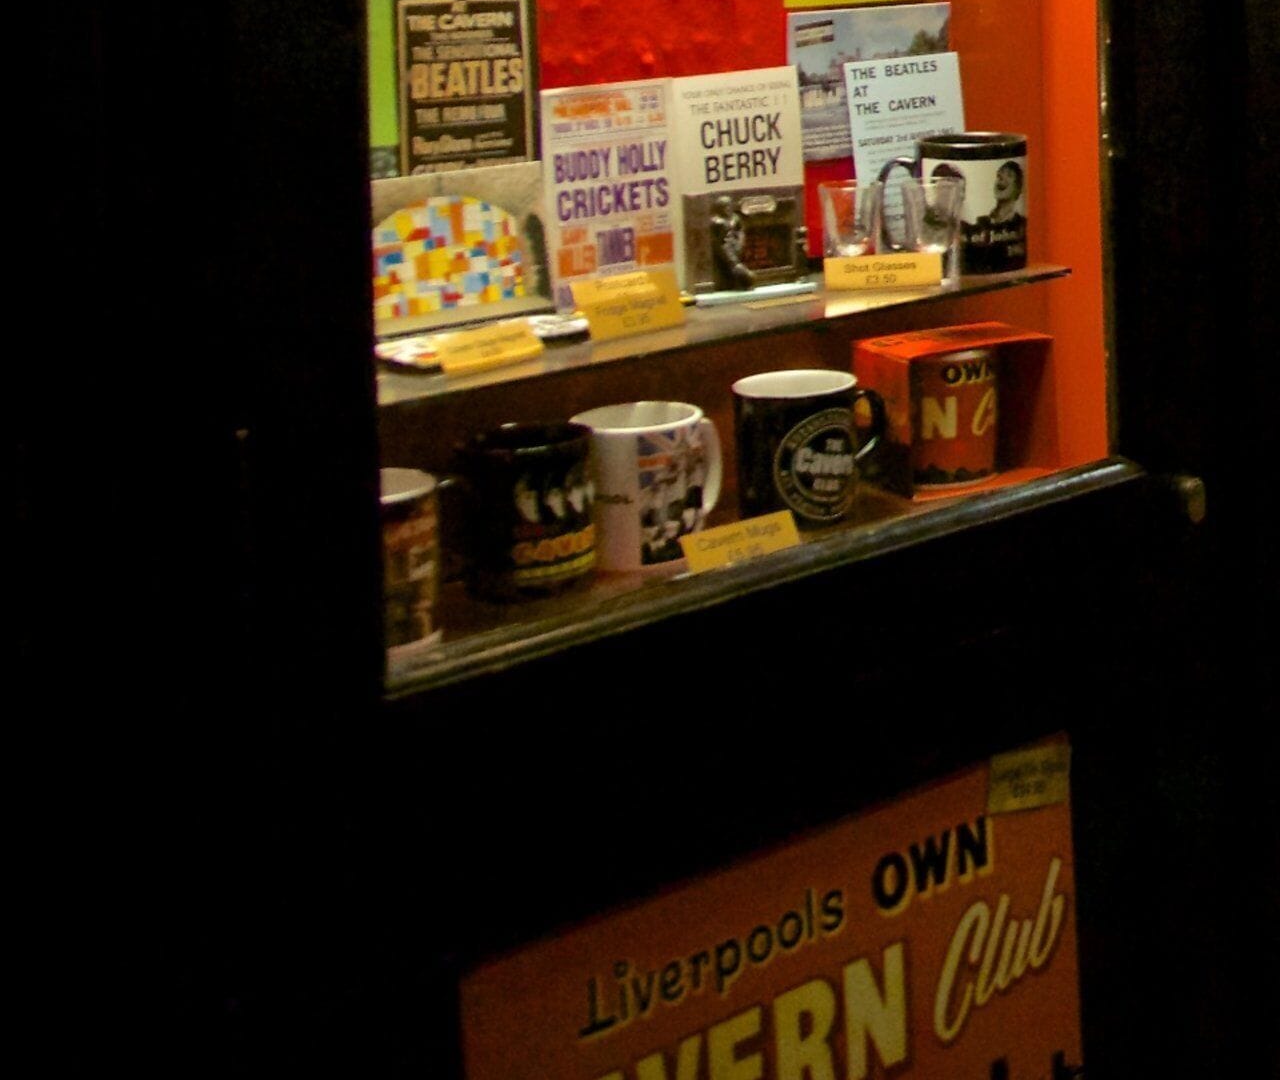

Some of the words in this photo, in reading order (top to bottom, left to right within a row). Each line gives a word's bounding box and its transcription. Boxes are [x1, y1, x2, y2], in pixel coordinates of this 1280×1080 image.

[410, 59, 523, 99] BEATLES
[849, 67, 878, 81] THE
[884, 61, 938, 78] BEATLES
[853, 85, 869, 99] AT
[855, 103, 882, 116] THE
[888, 95, 937, 113] CAVERN
[700, 112, 783, 150] CHUCK
[553, 147, 612, 184] BUDDY
[616, 140, 667, 177] HOLLY
[704, 146, 781, 185] BERRY
[557, 176, 670, 222] CRICKETS
[844, 262, 872, 274] Shot
[872, 260, 918, 273] Glasses
[578, 887, 845, 1040] Liverpools
[872, 817, 994, 915] OWN
[595, 942, 908, 1080] ERN
[933, 857, 1065, 1043] Club
